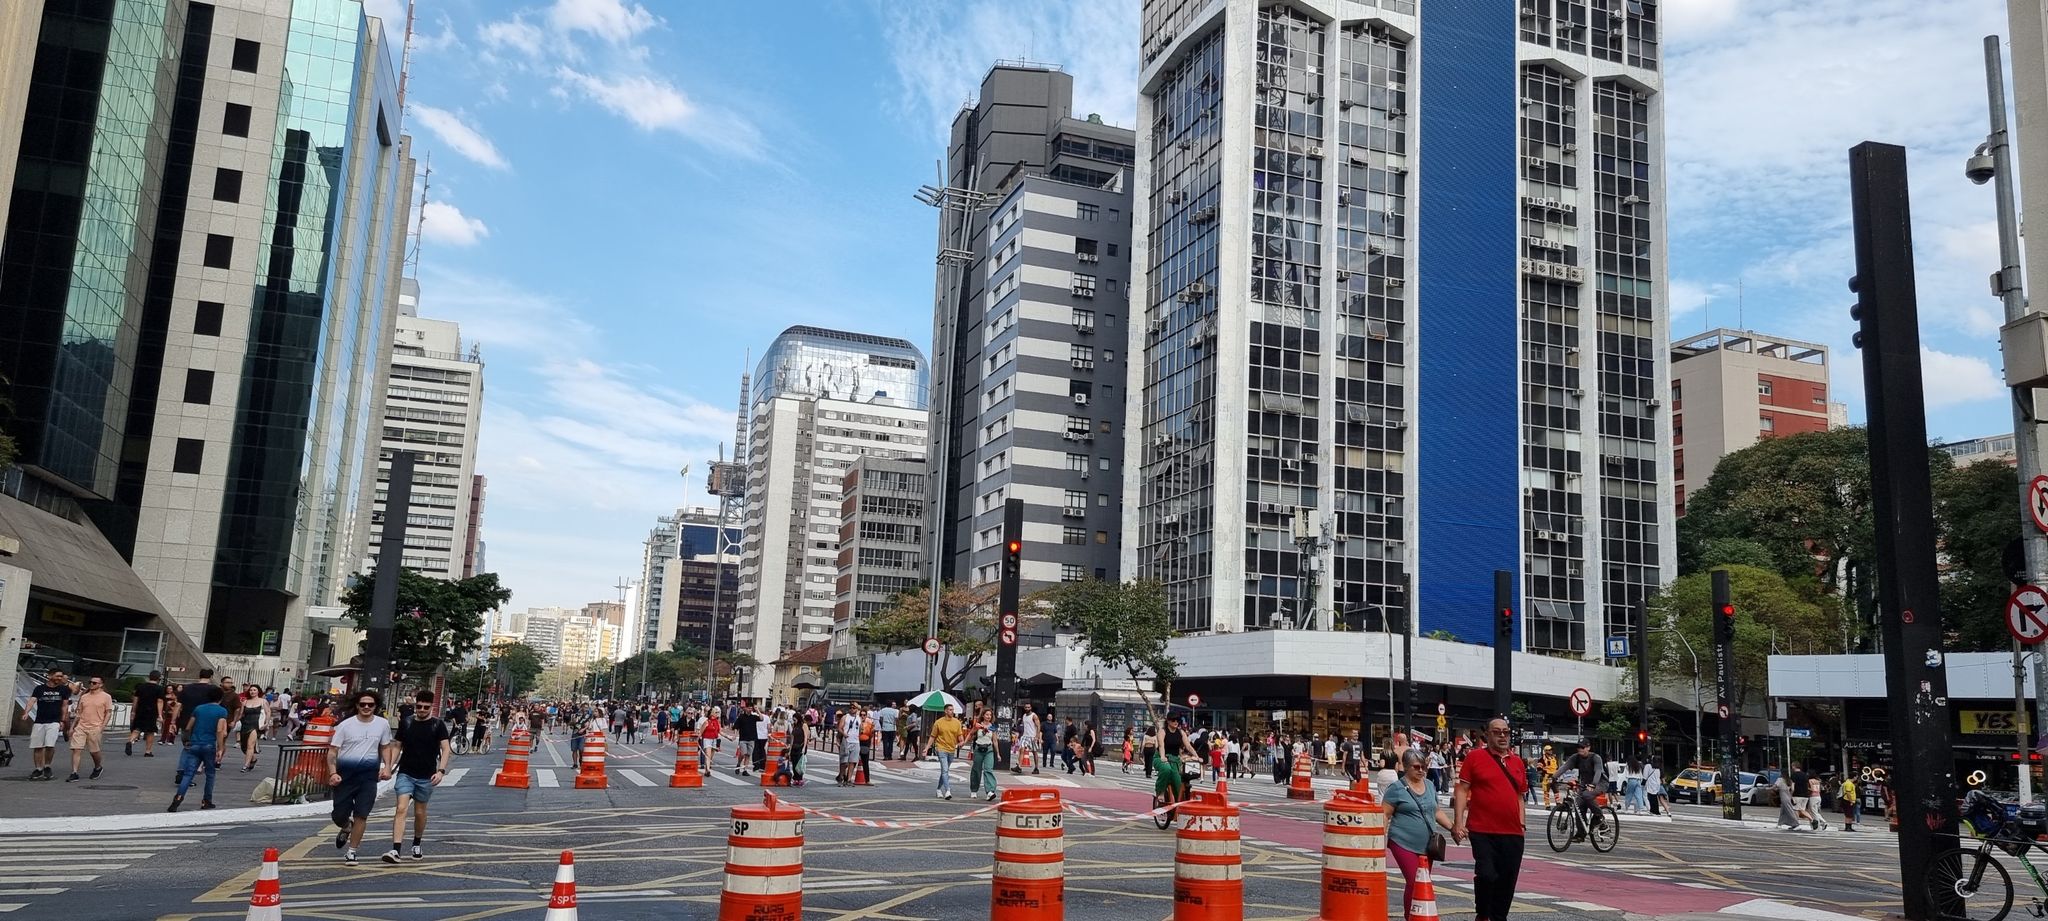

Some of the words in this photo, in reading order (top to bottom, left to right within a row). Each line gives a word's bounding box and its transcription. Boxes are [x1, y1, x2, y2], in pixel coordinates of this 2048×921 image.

[1004, 617, 1014, 625] 50
[1718, 685, 1726, 699] Av.
[1976, 712, 2016, 729] YES
[1015, 815, 1042, 828] CET
[1052, 814, 1062, 828] SP
[734, 821, 749, 836] SP
[250, 894, 268, 904] ET
[270, 893, 280, 904] SP
[557, 895, 570, 905] SP
